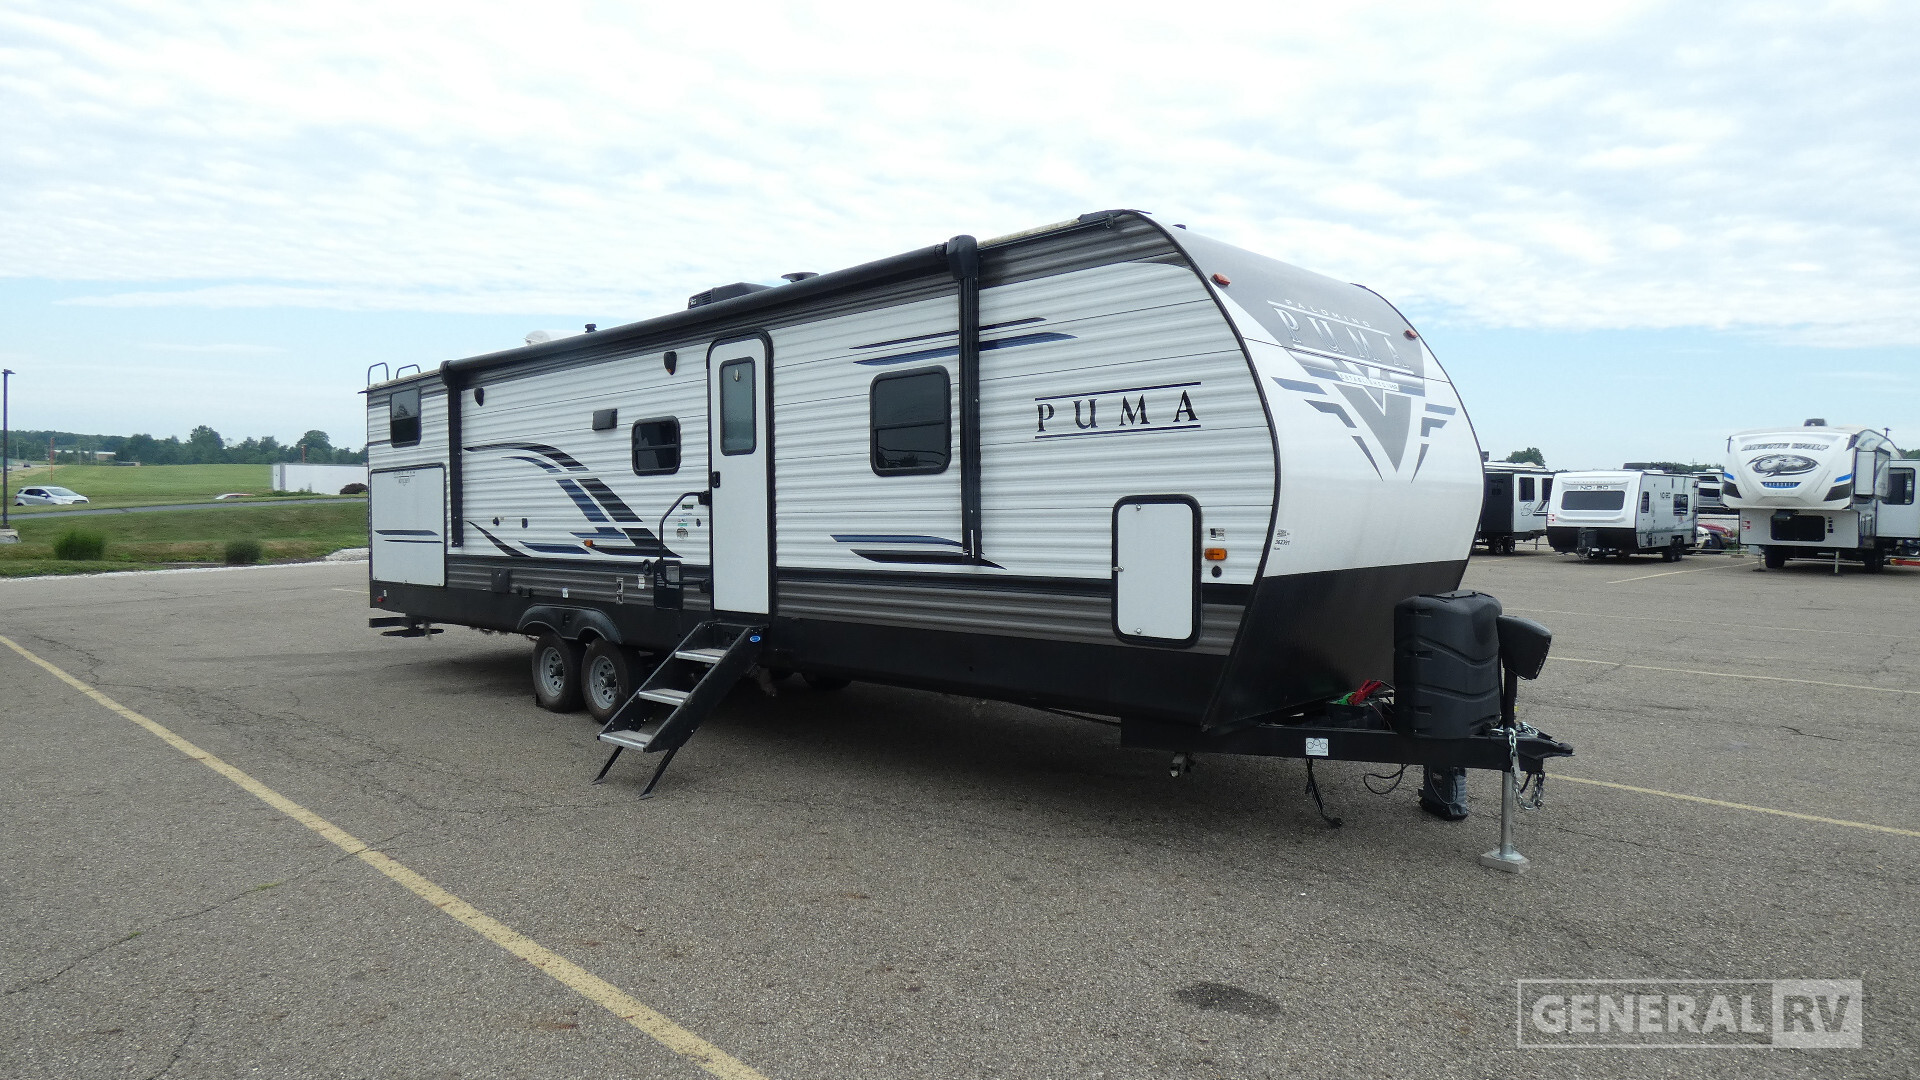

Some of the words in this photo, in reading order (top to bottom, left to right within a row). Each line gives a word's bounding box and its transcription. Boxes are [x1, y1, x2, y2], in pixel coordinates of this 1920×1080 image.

[1285, 299, 1371, 327] PALOMINO
[1274, 307, 1410, 368] PUMA
[1037, 390, 1199, 432] PUMA
[1791, 443, 1829, 451] WOLF
